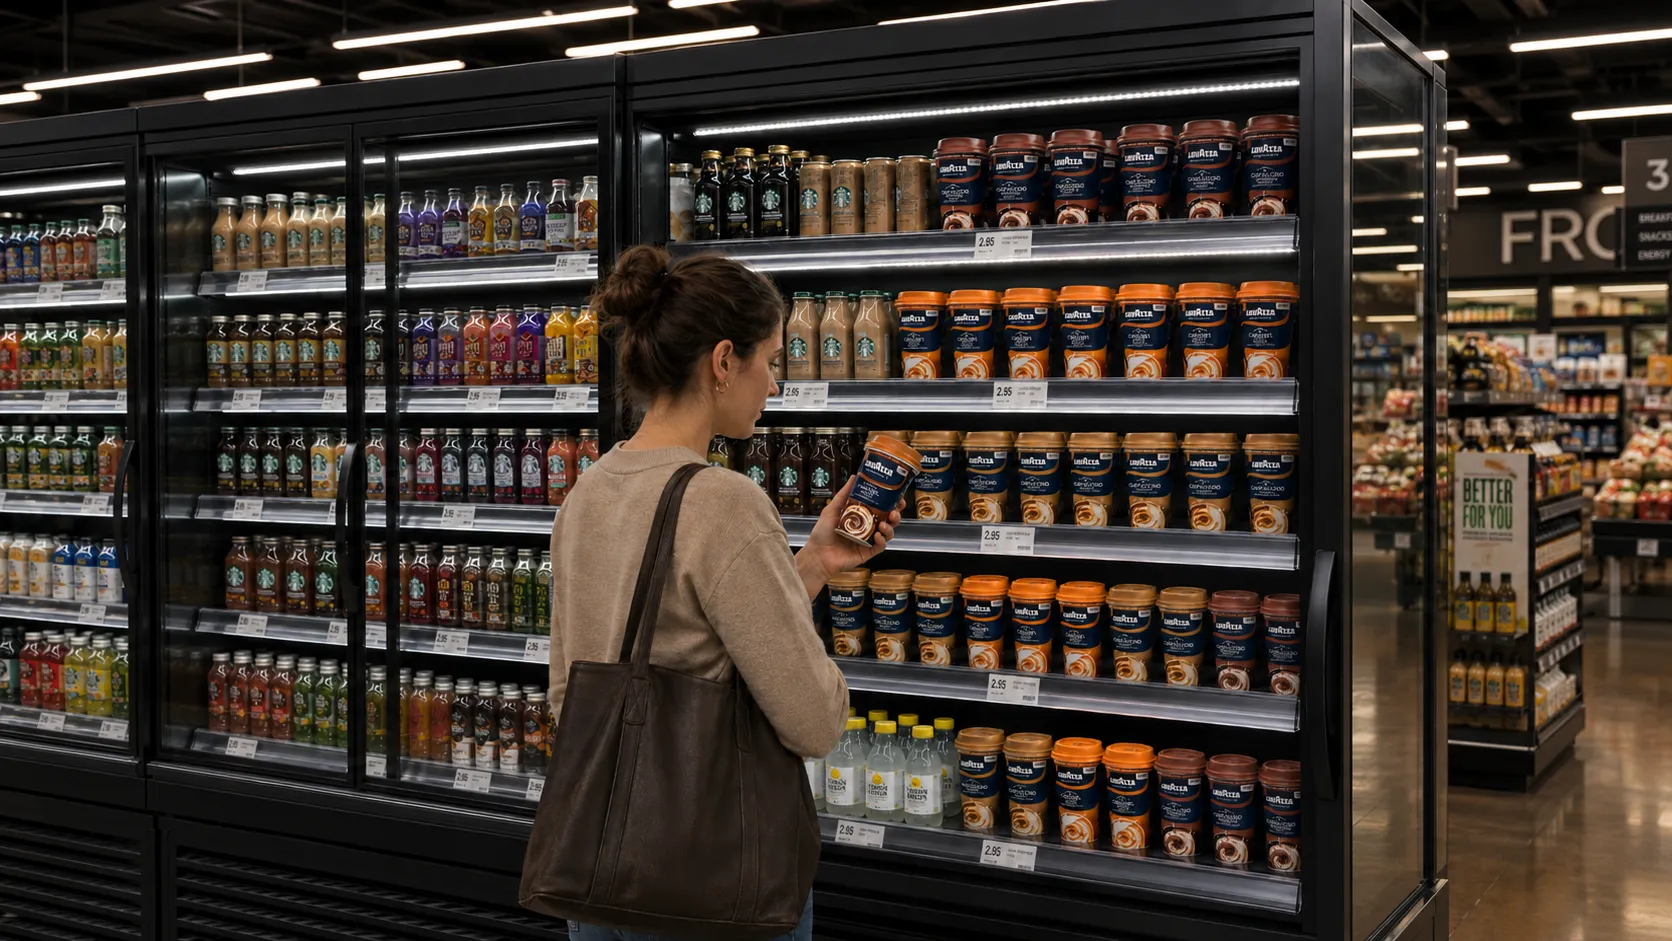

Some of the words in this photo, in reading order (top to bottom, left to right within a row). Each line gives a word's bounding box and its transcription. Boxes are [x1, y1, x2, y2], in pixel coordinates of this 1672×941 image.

[1646, 159, 1669, 191] 3
[979, 236, 995, 247] 2.95
[1463, 478, 1512, 504] BETTER
[1463, 504, 1486, 529] FOR
[1489, 505, 1513, 530] YOU
[984, 530, 1000, 541] 2.95
